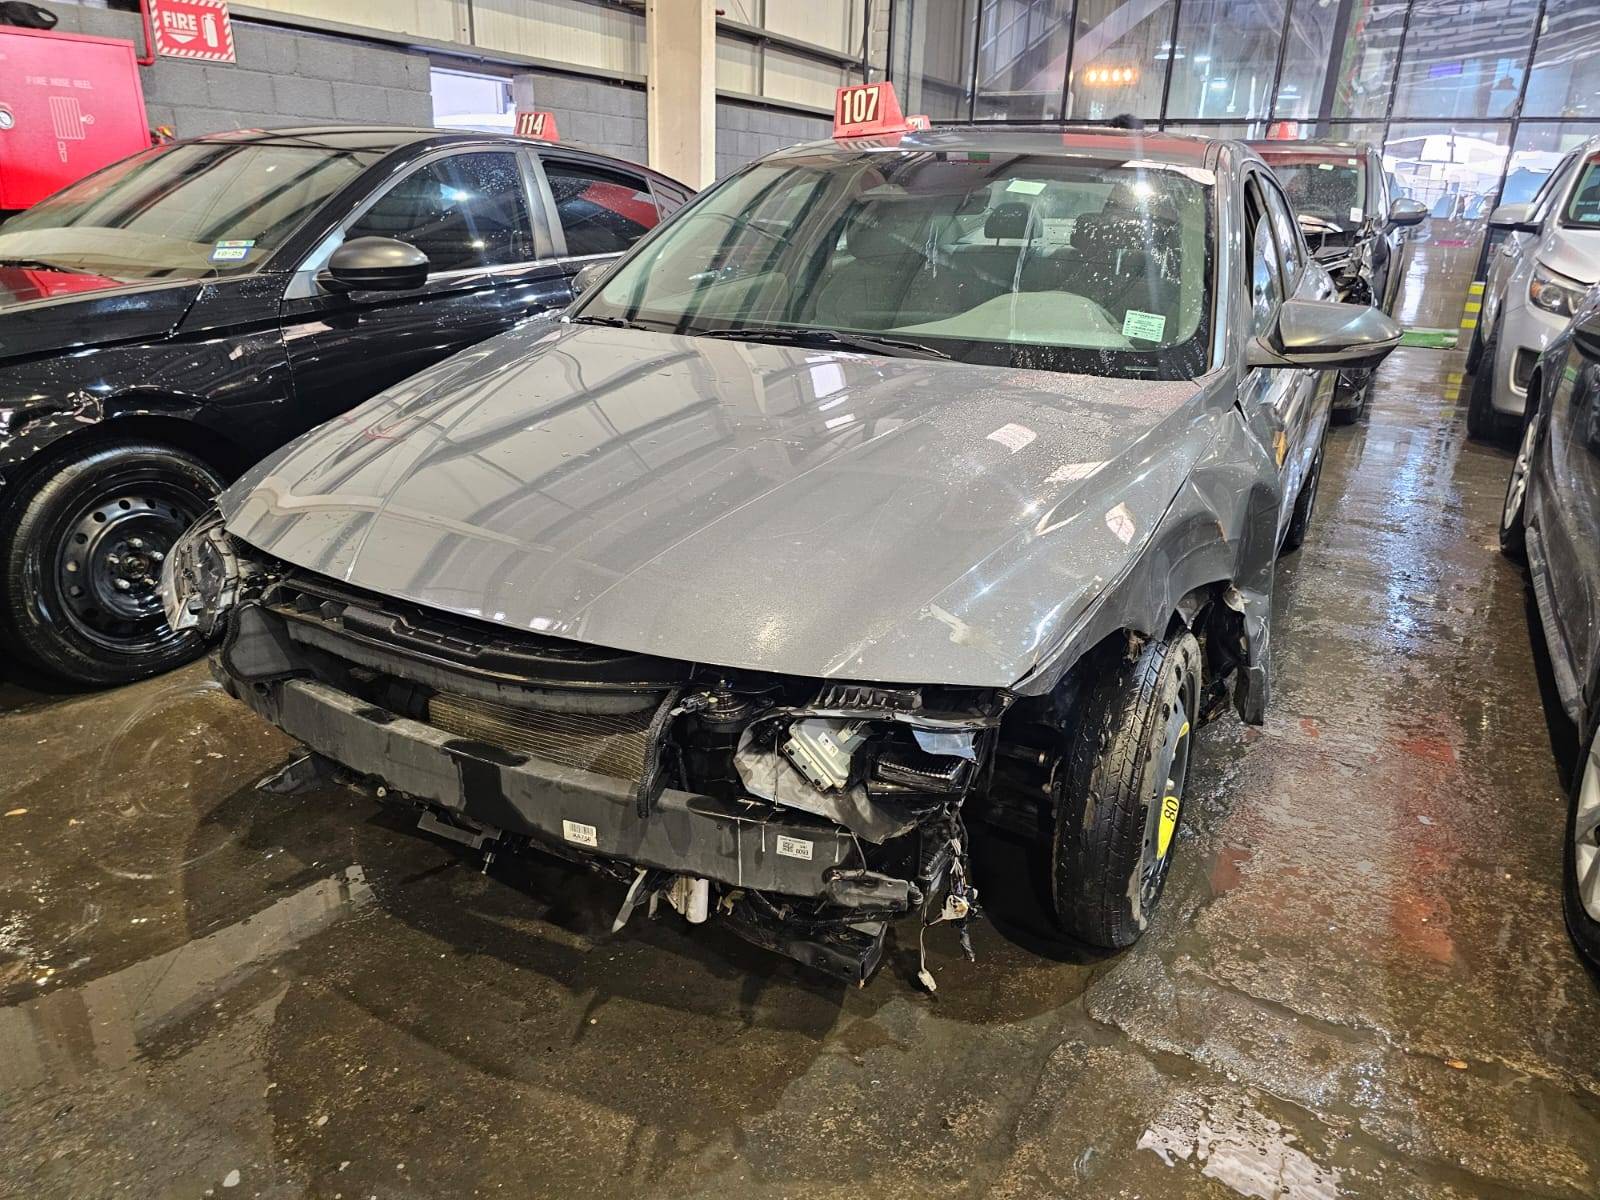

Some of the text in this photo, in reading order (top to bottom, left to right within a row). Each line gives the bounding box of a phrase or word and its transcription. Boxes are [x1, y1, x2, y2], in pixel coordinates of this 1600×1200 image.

[162, 11, 198, 30] FIRE
[843, 86, 878, 123] 107
[521, 114, 545, 135] 114
